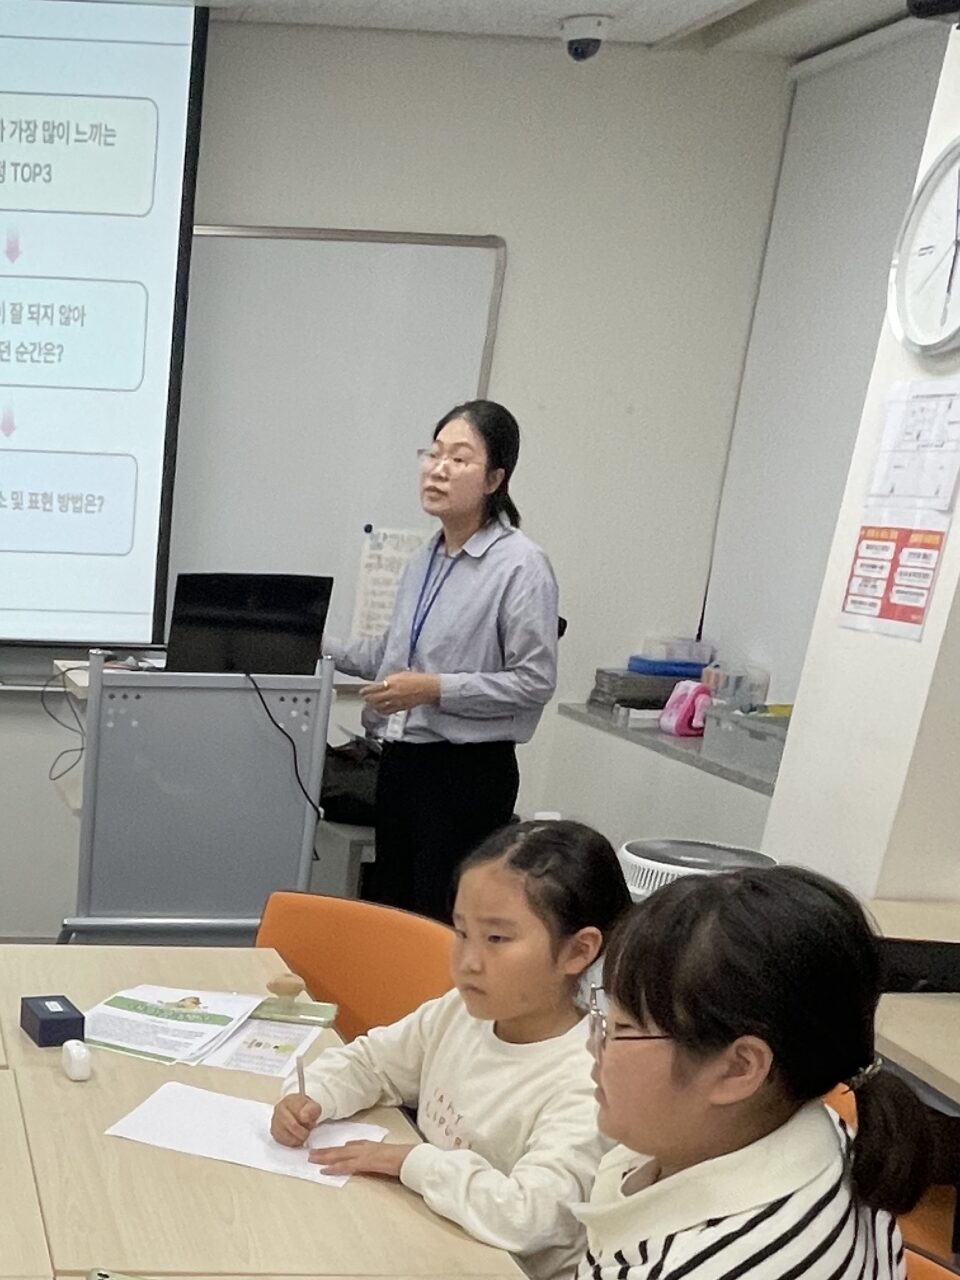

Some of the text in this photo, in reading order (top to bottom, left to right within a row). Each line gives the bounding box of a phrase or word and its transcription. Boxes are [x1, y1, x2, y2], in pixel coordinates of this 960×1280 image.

[9, 119, 38, 145] 가장
[42, 120, 70, 146] 많이
[74, 123, 117, 148] 느끼는
[10, 161, 52, 184] TOP3
[9, 302, 24, 326] 잘
[27, 303, 54, 326] 되지
[58, 304, 86, 327] 않아
[15, 341, 65, 364] 순간은?
[10, 490, 24, 511] 및
[27, 491, 54, 513] 표현
[57, 493, 105, 514] 방법은?
